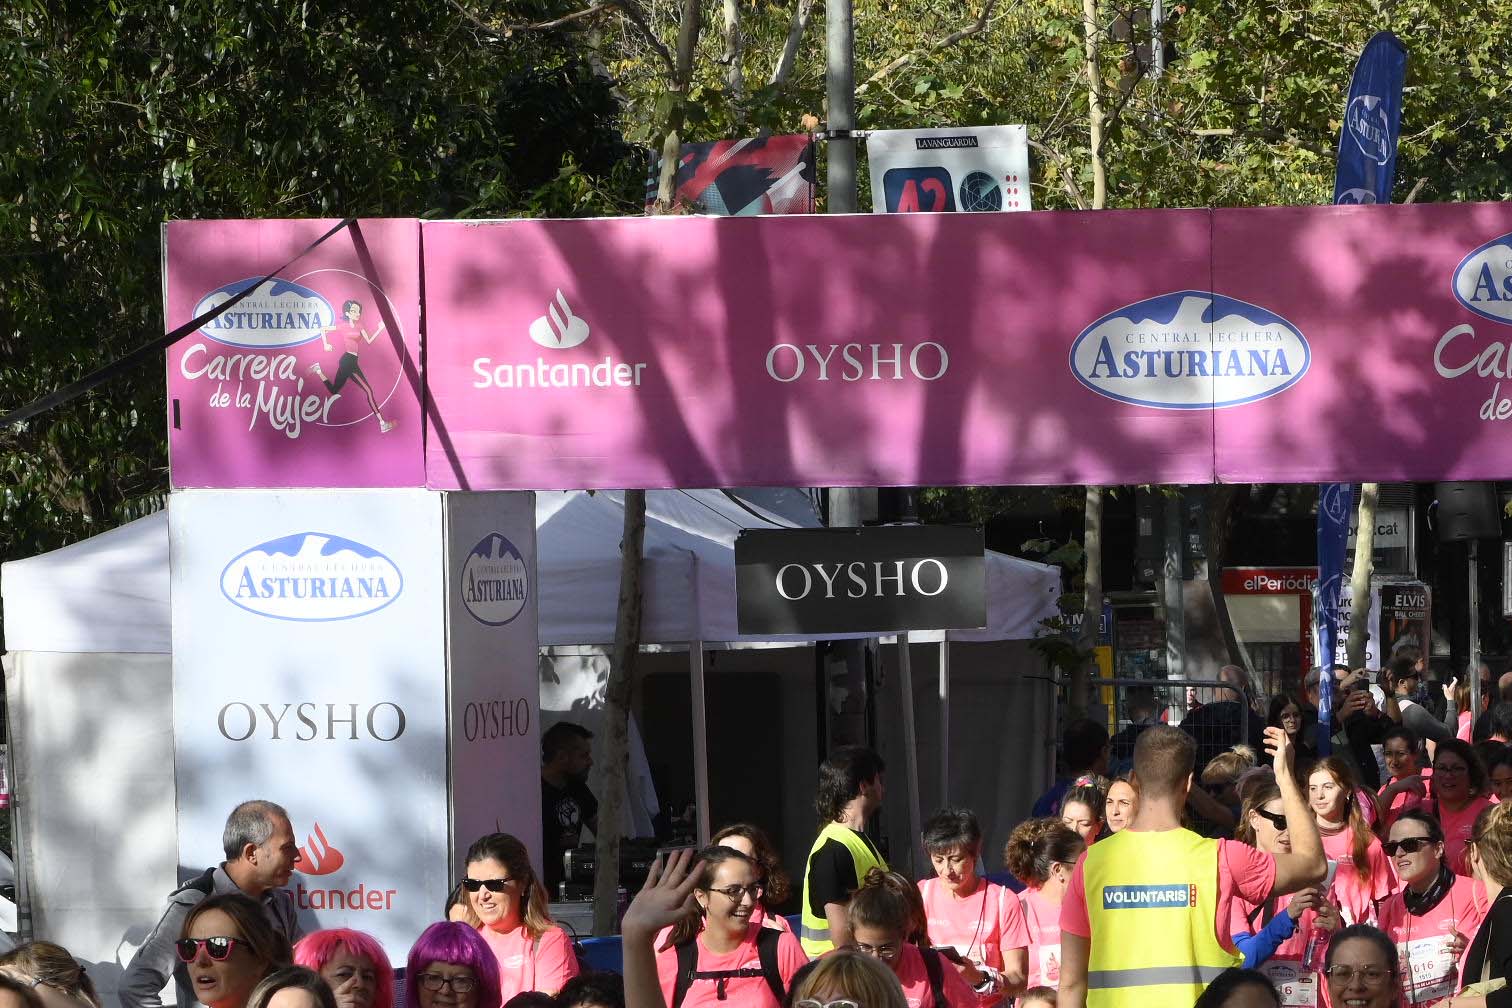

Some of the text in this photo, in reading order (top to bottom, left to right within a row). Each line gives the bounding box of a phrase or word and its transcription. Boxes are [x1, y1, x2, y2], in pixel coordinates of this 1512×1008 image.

[928, 137, 977, 148] VANGUARDIA
[1125, 330, 1284, 344] CENTRAL LECHERA
[180, 344, 297, 380] Carrera
[472, 356, 647, 389] Santander
[765, 341, 949, 383] OYSHO
[1088, 335, 1292, 380] ASTURIANA
[209, 377, 341, 438] de la Mujer
[234, 564, 390, 600] ASTURIANA
[465, 566, 524, 602] ASTURIANA
[775, 558, 949, 601] OYSHO
[217, 702, 407, 742] OYSHO
[463, 697, 530, 742] OYSHO
[1105, 889, 1187, 904] VOLUNTARIS
[1413, 960, 1434, 973] 016
